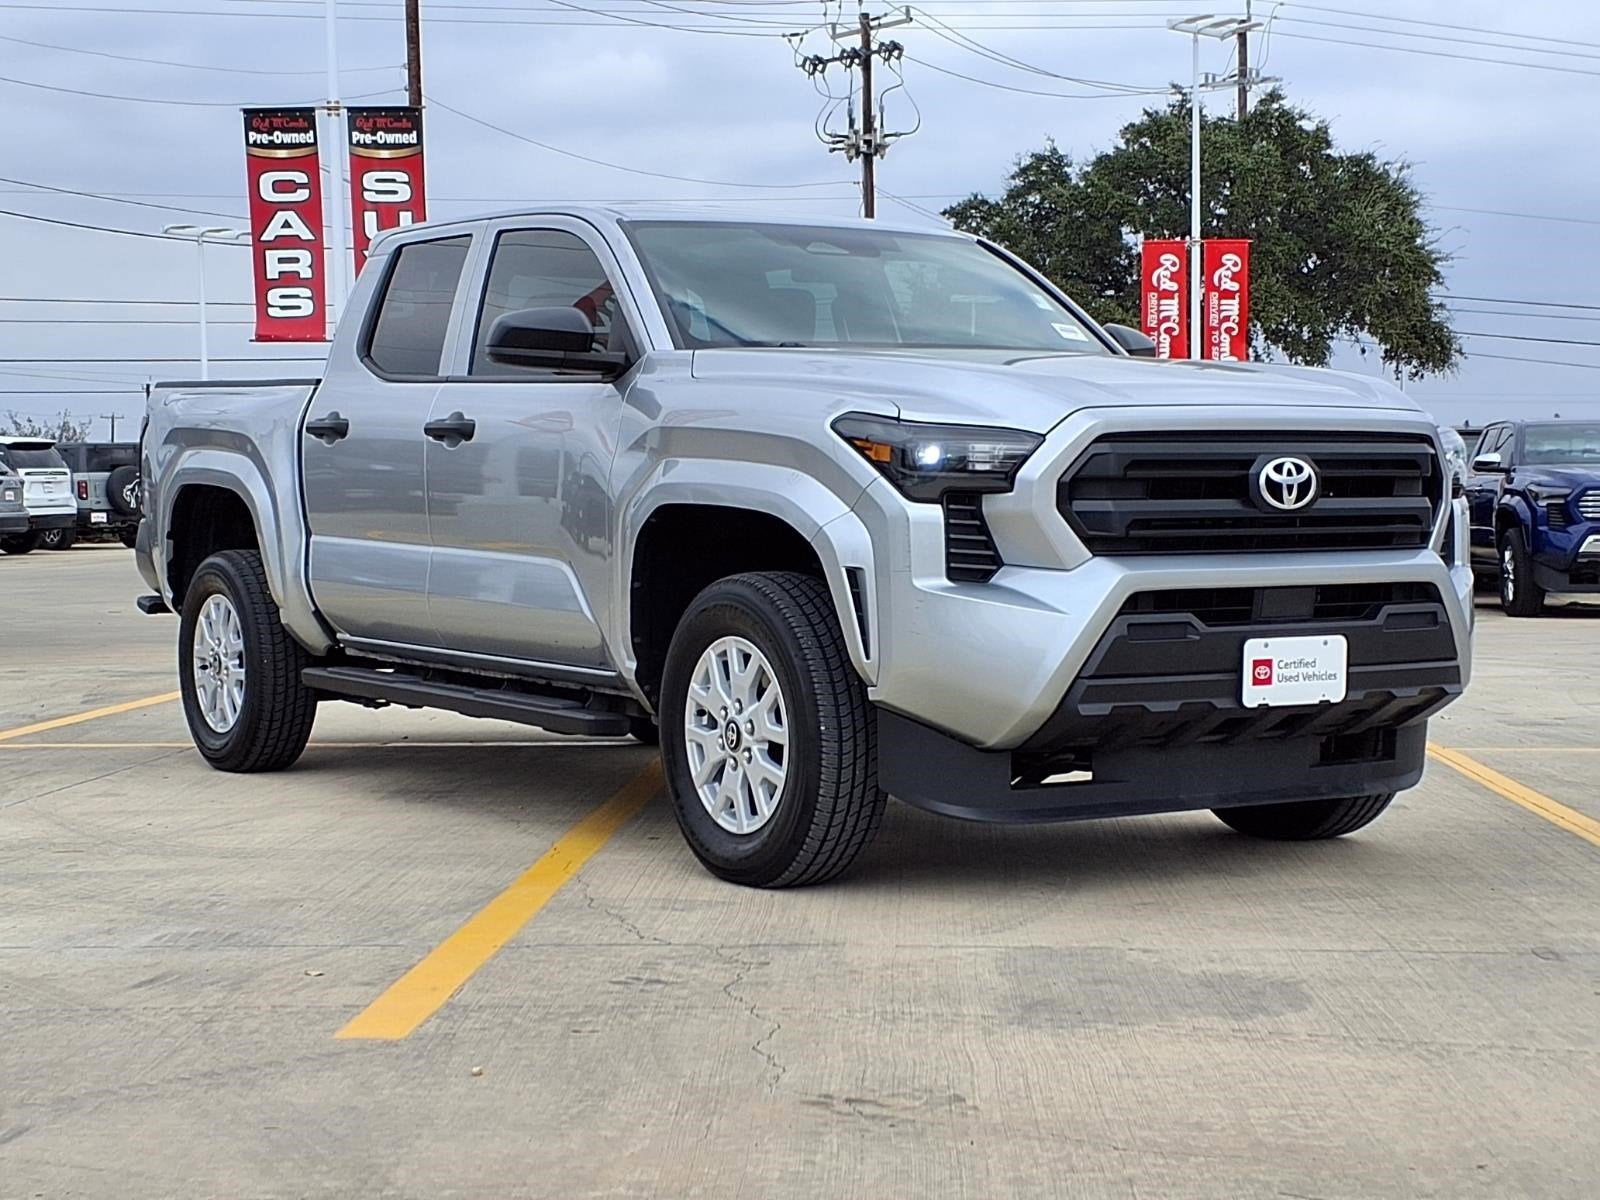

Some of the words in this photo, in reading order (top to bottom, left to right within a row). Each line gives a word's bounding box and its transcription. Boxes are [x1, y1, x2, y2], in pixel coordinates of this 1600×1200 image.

[248, 130, 315, 144] Pre-Owned
[351, 130, 418, 144] Pre-Owned
[362, 171, 412, 258] SU
[258, 171, 317, 317] CARS
[1152, 253, 1180, 291] Red
[1213, 253, 1242, 291] Red
[1148, 291, 1158, 328] DRIVEN
[1210, 291, 1219, 328] DRIVEN
[1211, 330, 1219, 344] TO
[1277, 658, 1317, 670] Certified
[1277, 672, 1300, 683] Used
[1301, 671, 1338, 682] Vehicles
